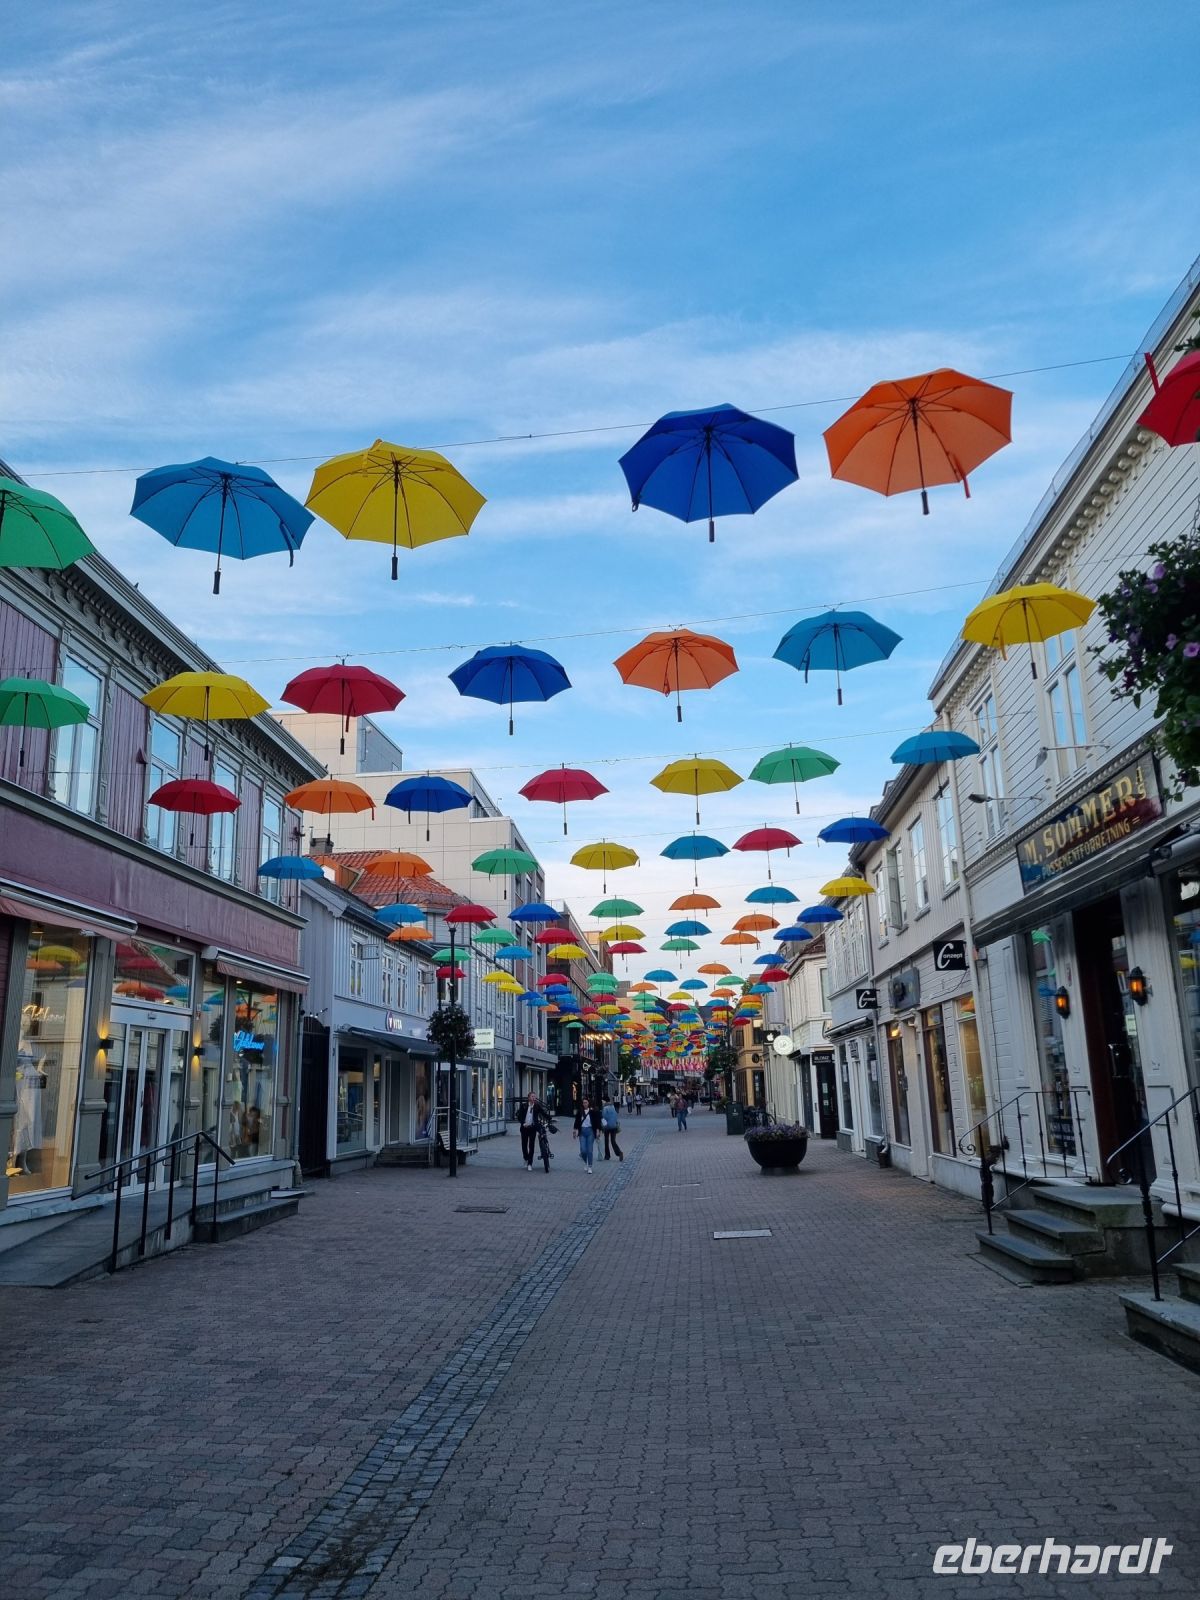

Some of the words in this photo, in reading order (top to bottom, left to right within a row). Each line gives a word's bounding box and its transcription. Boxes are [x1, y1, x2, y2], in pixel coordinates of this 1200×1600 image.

[1023, 839, 1043, 868] M.
[1043, 776, 1136, 857] SOMMER
[937, 942, 963, 969] Conzept
